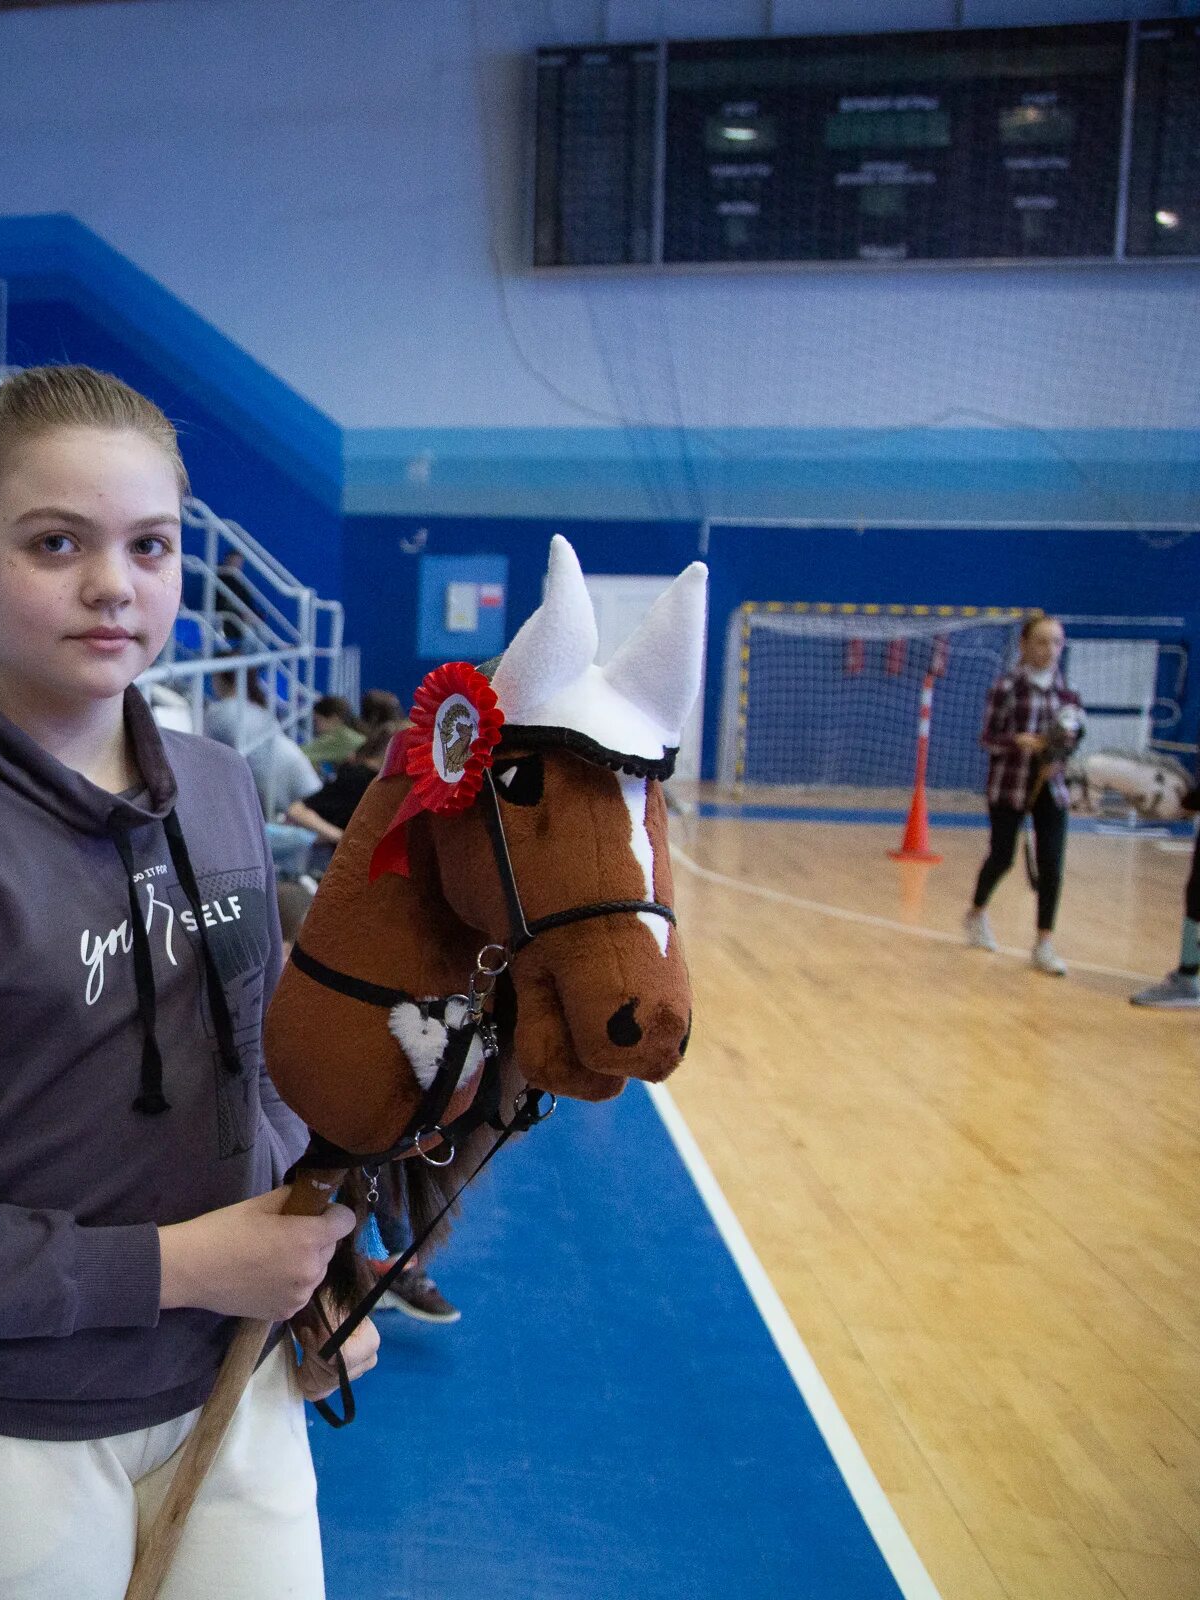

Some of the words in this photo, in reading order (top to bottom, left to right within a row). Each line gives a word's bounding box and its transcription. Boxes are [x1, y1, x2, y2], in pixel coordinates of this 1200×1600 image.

[144, 867, 156, 878] IT
[155, 864, 168, 876] FOR
[180, 896, 242, 932] SELF
